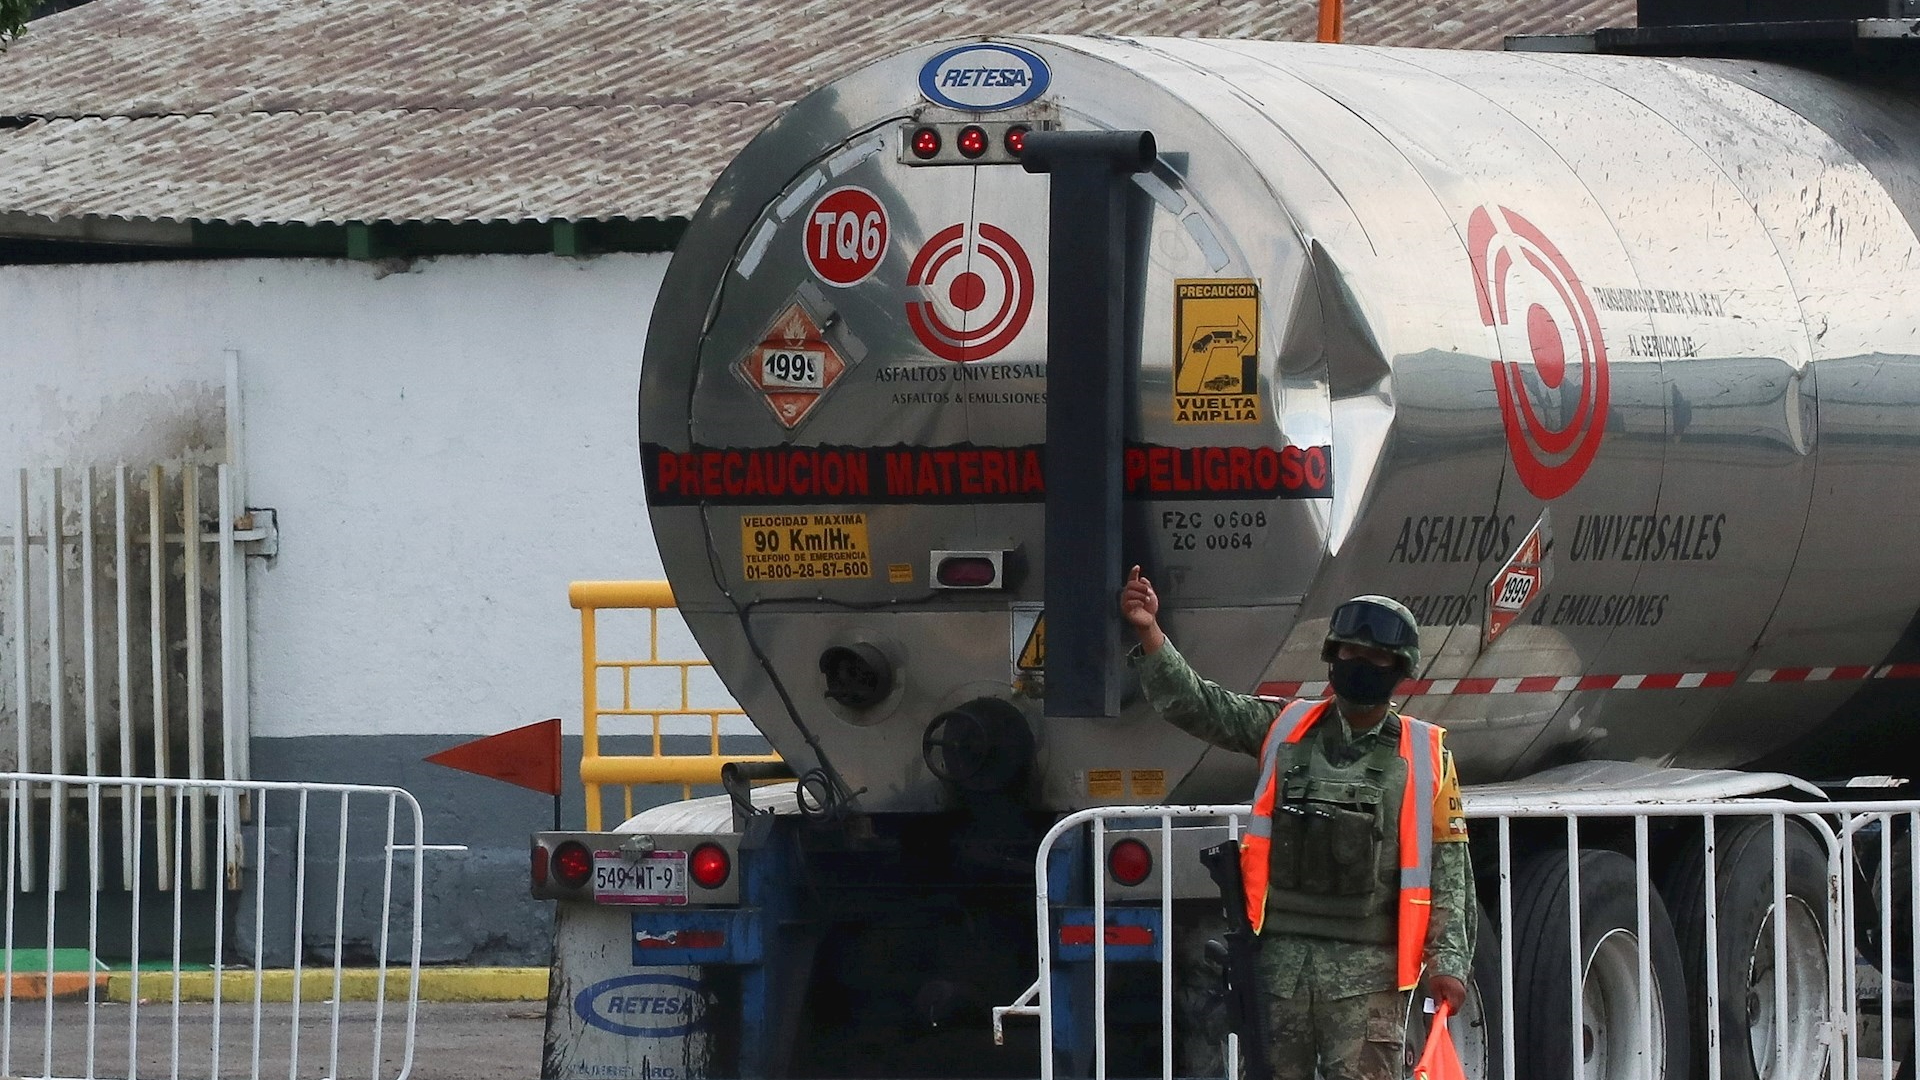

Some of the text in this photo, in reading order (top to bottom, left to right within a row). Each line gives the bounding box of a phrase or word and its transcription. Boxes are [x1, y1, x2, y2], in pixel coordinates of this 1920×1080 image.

[941, 68, 1027, 87] RETESA
[814, 210, 882, 264] TQ6
[1179, 285, 1256, 298] PRECAUCION
[1628, 334, 1641, 357] AL
[1640, 335, 1681, 358] SERVICIO
[875, 364, 1047, 382] ASFALTOS UNIVERSAL
[892, 392, 1047, 405] ASFALTOS & EMULSIONES
[1176, 397, 1257, 410] VUELTA
[782, 403, 798, 417] 3
[1176, 409, 1257, 422] AMPLIA
[656, 445, 1328, 497] PRECAUCION MATERIA PELIGROSO
[744, 514, 863, 528] VELOCIDAD MAXIMA
[1162, 510, 1267, 530] FZC 0608
[754, 527, 856, 553] 90 Km/Hr.
[1172, 532, 1253, 551] ZC 0064
[1389, 513, 1727, 564] ASFALTOS UNIVERSALES
[746, 551, 867, 564] TELEFONO DE EMERGENCIA
[746, 561, 868, 579] 01-800-28-87-600
[1501, 576, 1531, 604] 1999
[1531, 593, 1551, 627] &
[1550, 594, 1669, 627] EMULSIONES
[1491, 622, 1501, 634] 3
[597, 866, 673, 890] 549-WT-9
[607, 996, 694, 1016] RETESA
